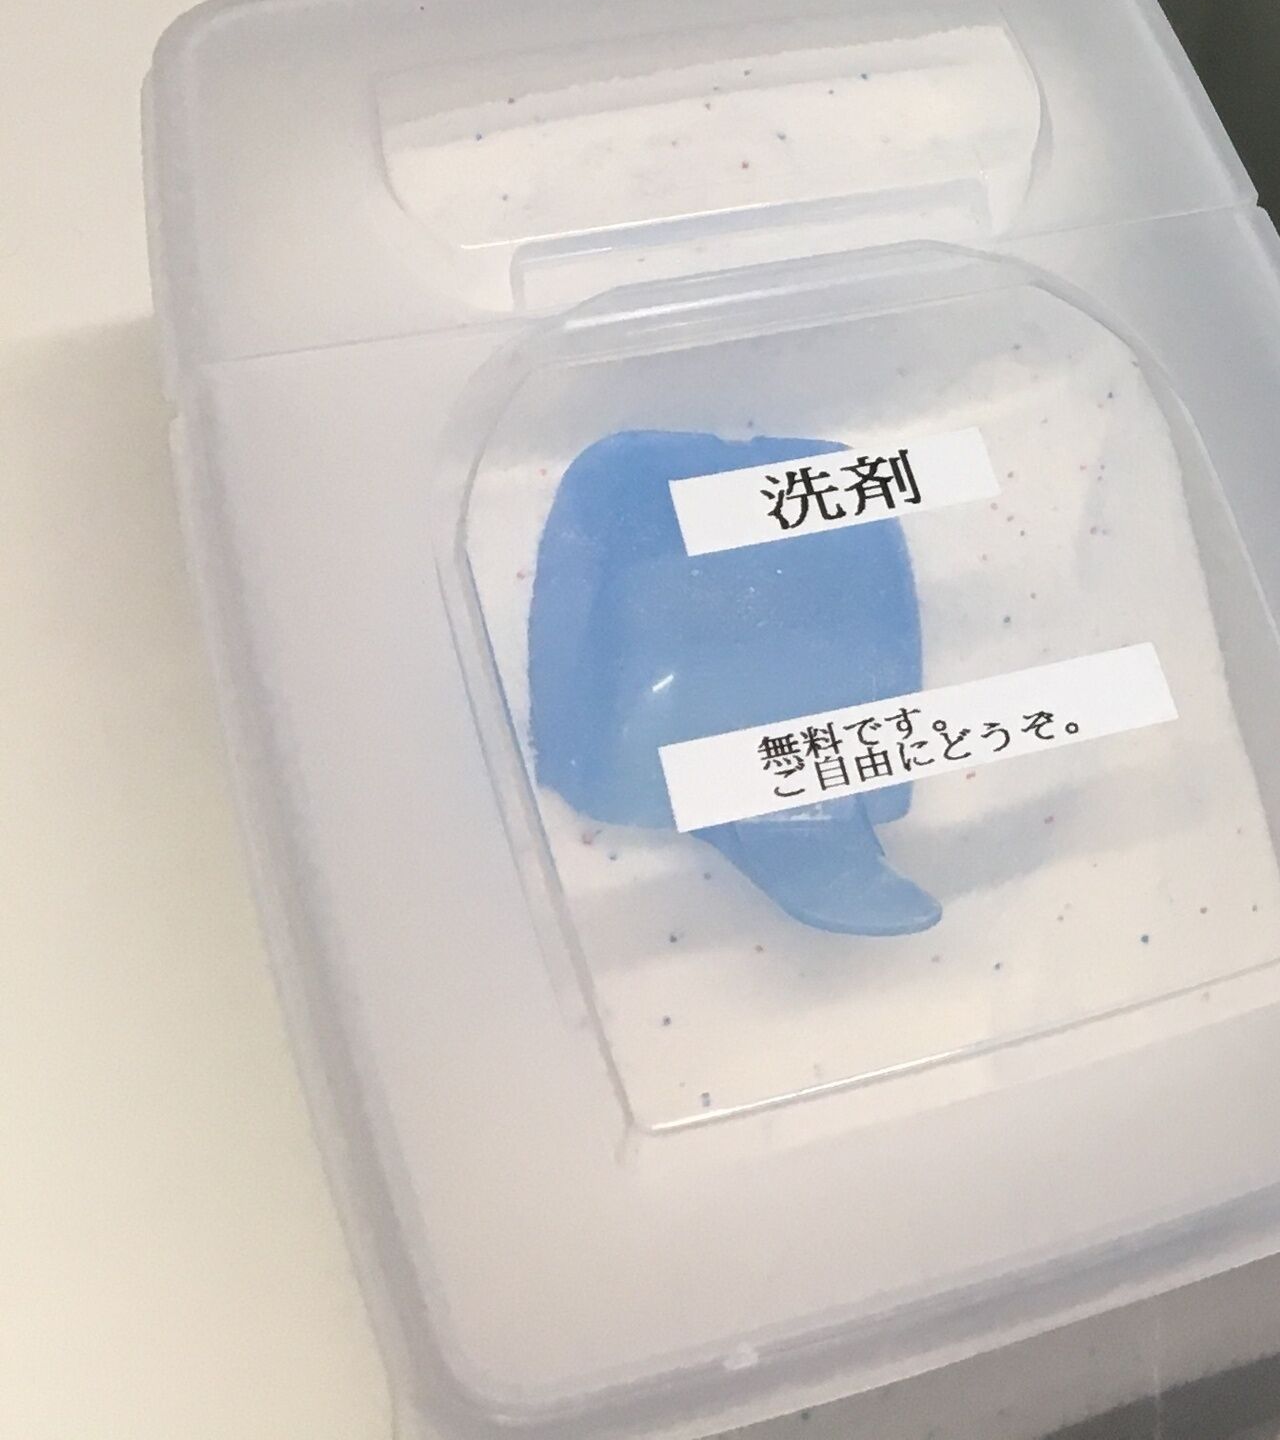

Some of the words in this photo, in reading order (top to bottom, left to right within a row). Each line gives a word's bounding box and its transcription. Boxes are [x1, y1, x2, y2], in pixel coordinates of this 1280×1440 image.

[760, 449, 921, 530] 洗剤
[757, 707, 946, 772] 無料です。
[772, 710, 1079, 797] ご自由にどうぞ。
